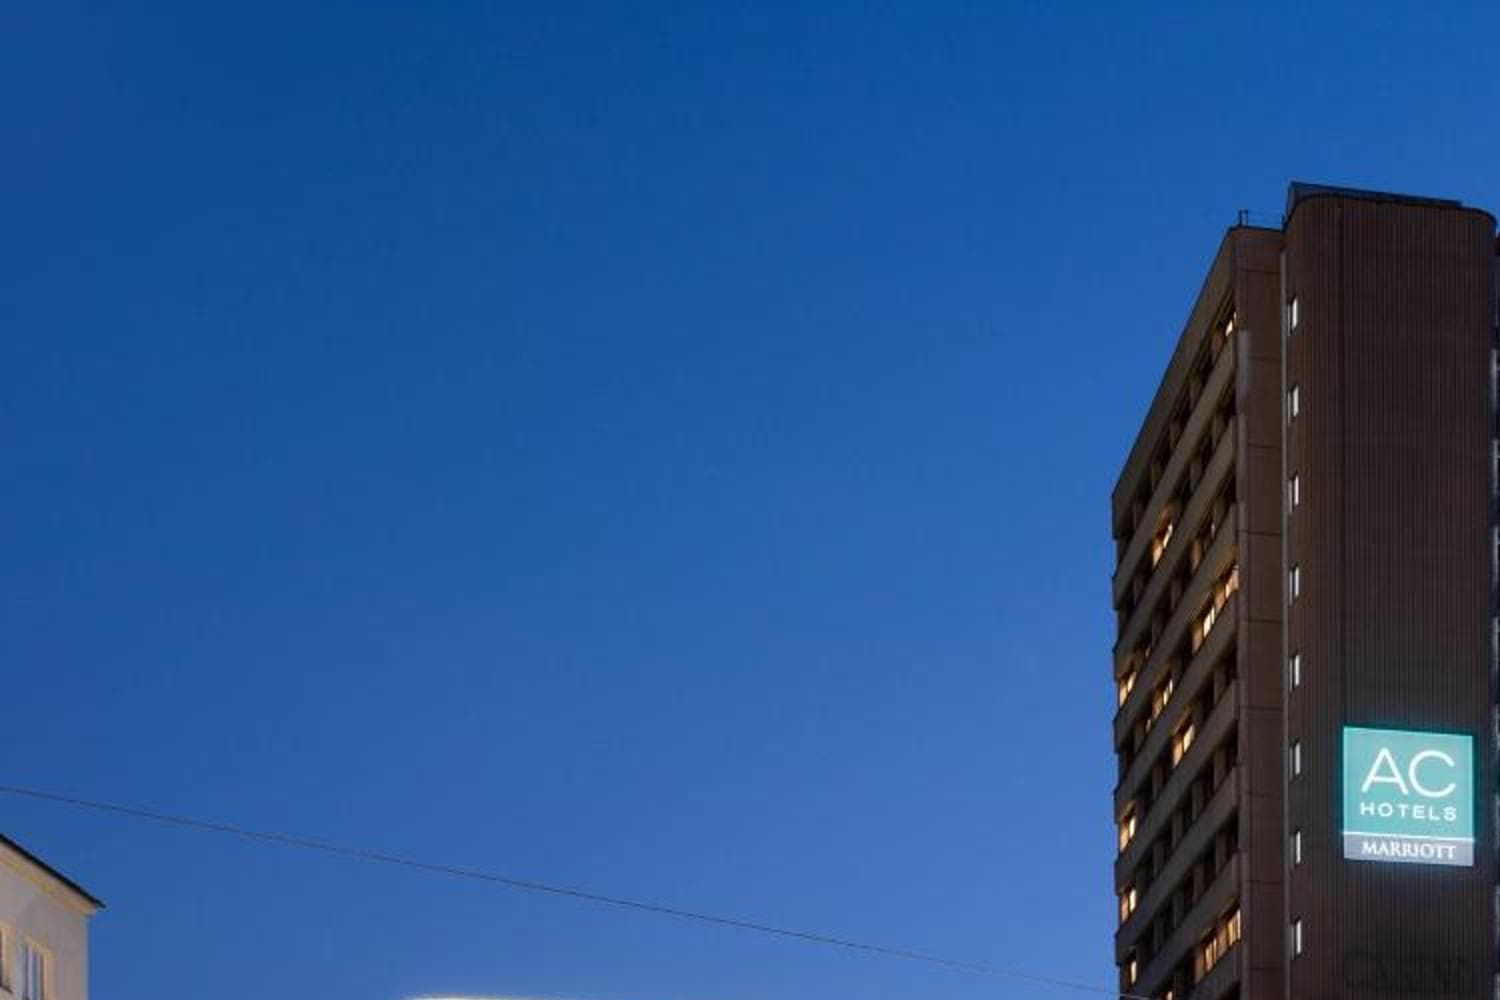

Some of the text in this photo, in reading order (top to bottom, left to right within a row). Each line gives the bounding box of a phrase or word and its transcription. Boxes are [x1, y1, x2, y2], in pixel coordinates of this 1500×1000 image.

[1361, 747, 1457, 798] AC
[1360, 802, 1457, 821] HOTELS
[1360, 840, 1457, 860] MARRIOTT
